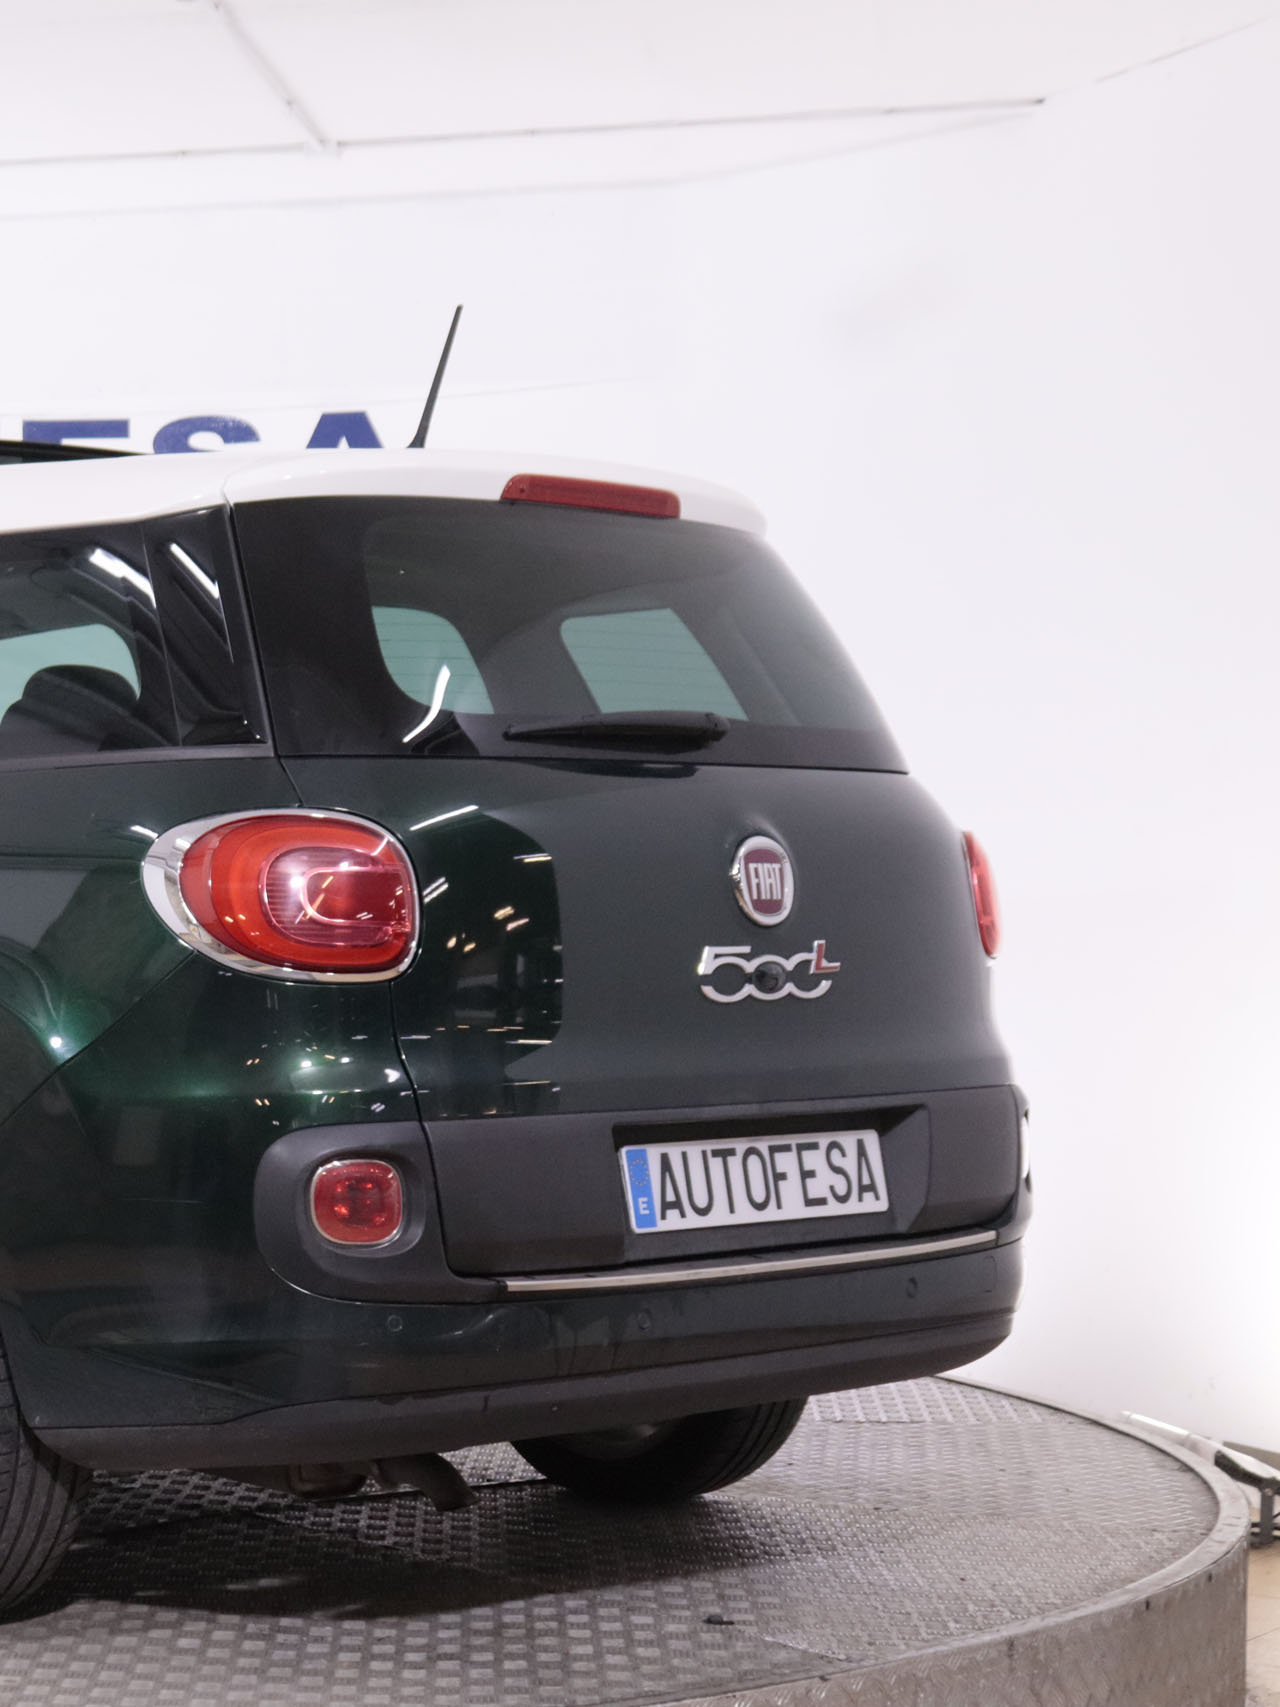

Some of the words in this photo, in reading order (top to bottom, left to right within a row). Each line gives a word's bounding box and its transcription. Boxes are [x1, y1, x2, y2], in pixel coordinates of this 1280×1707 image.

[748, 862, 783, 901] FIAT
[638, 1197, 650, 1215] E
[660, 1138, 880, 1221] AUTOFESA
